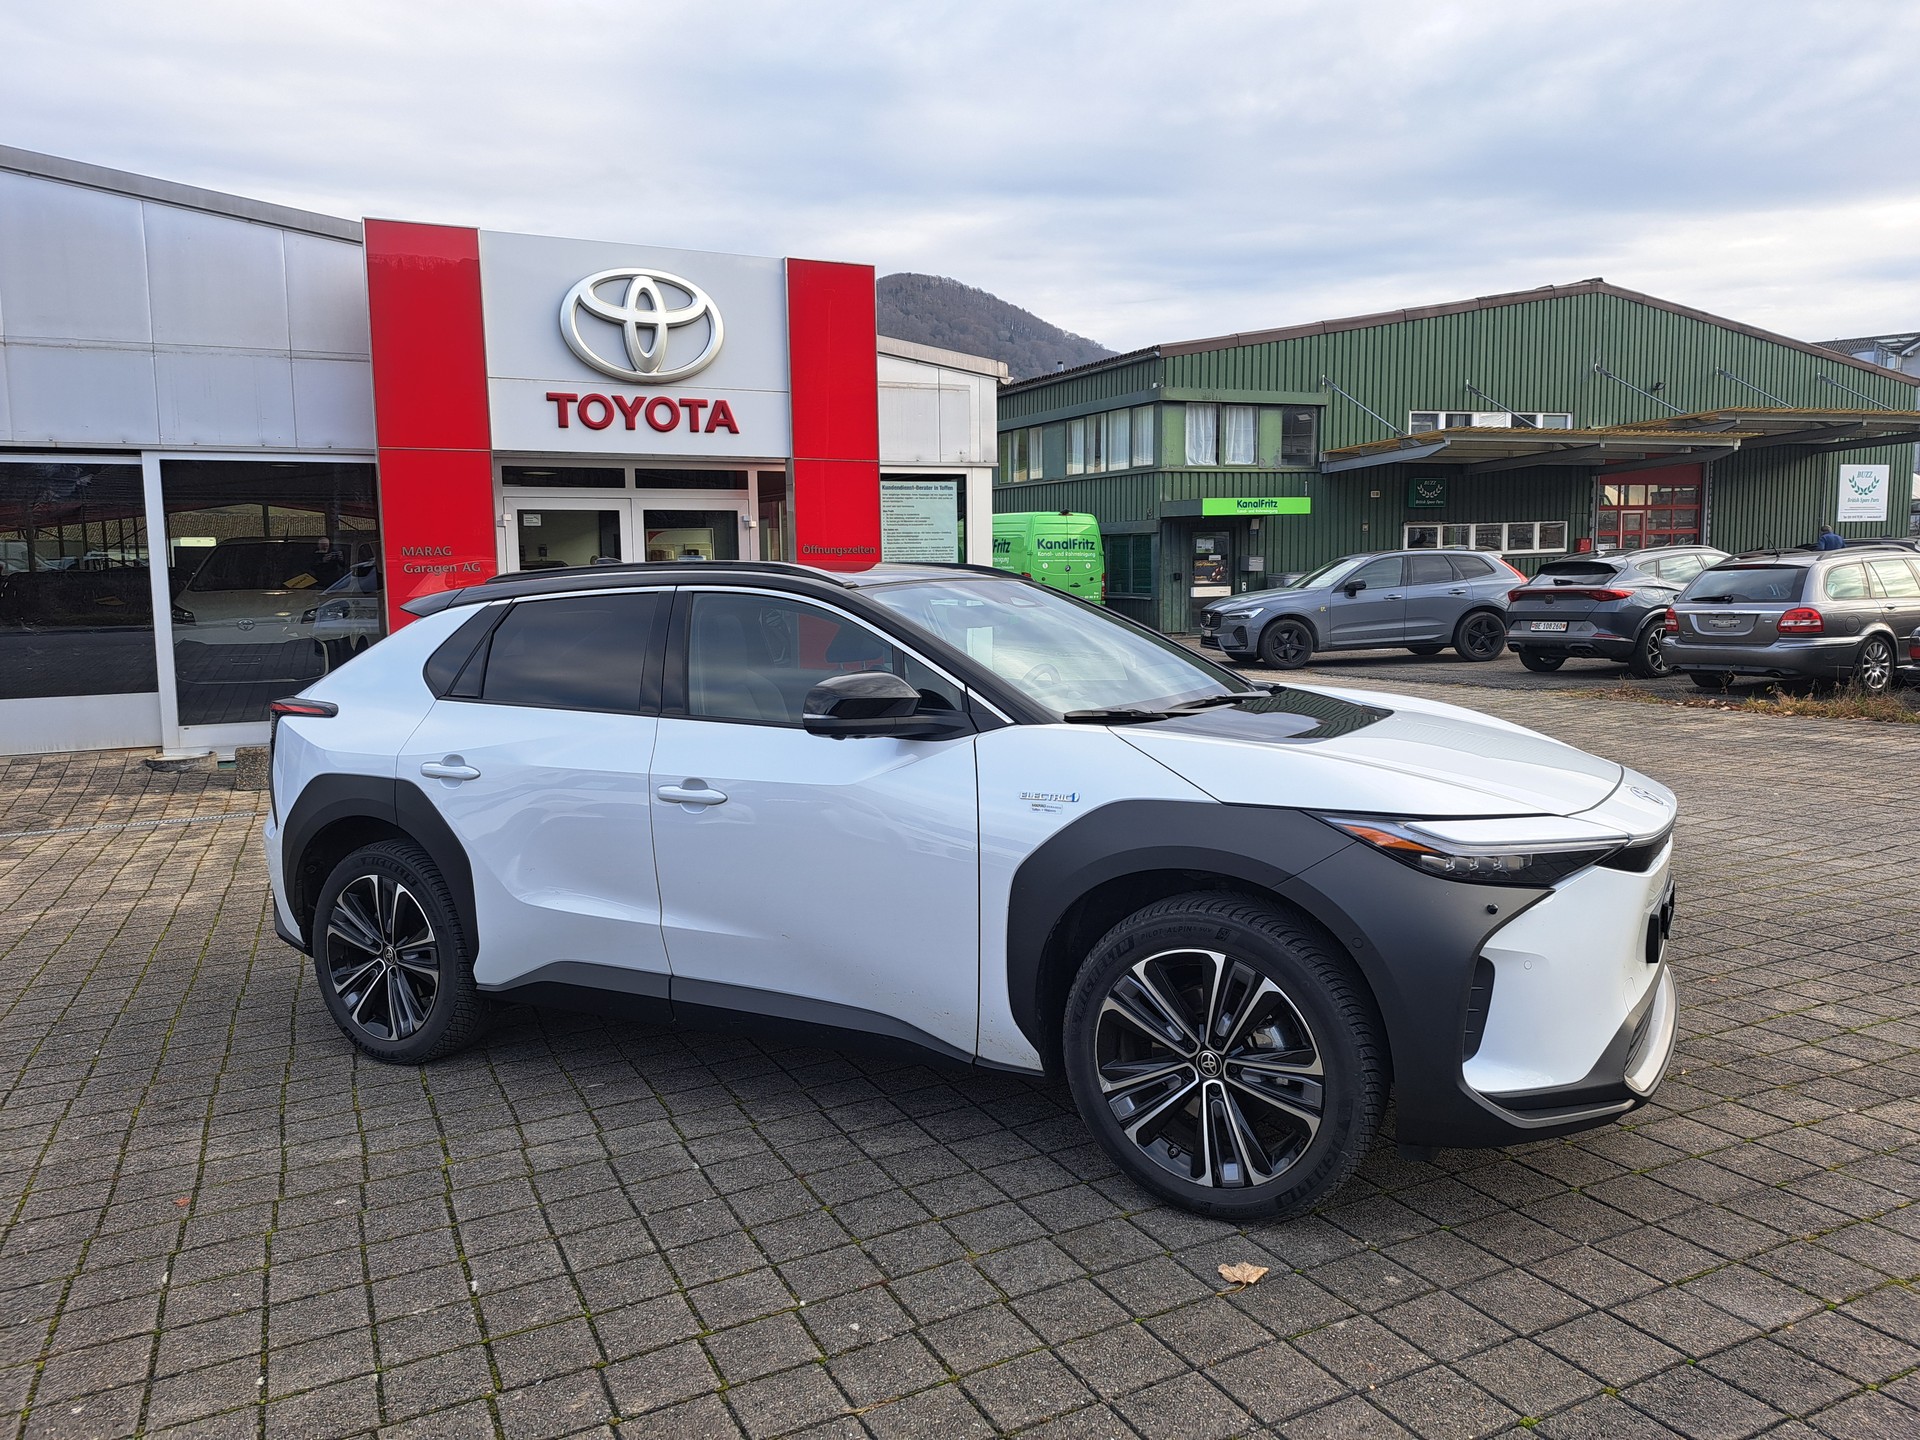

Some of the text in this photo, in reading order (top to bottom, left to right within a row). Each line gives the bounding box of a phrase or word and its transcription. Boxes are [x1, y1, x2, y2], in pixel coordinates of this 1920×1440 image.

[546, 392, 740, 434] TOYOTA
[1236, 499, 1278, 508] KanalFritz
[992, 538, 1011, 553] Fritz
[1037, 538, 1096, 550] KanalFritz
[402, 546, 452, 556] MARAG
[403, 562, 481, 576] Garagen AG
[1140, 928, 1164, 940] PILOT
[1072, 937, 1131, 1025] MICHELIN
